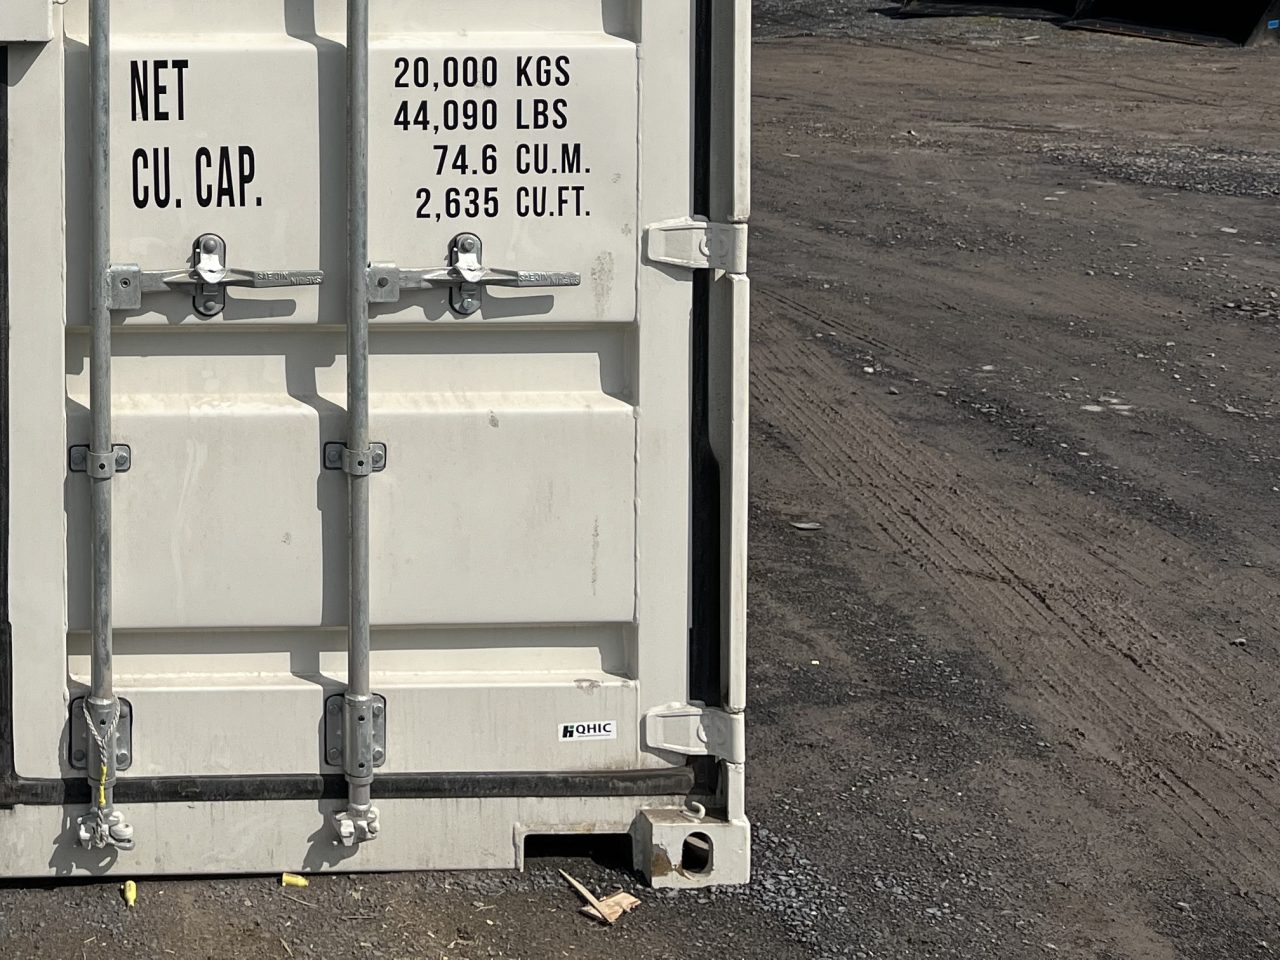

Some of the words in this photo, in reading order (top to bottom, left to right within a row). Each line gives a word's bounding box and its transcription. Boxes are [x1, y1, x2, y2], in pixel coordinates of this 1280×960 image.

[130, 59, 189, 122] NET
[394, 56, 498, 92] 20,000
[516, 55, 570, 87] KGS
[393, 99, 497, 135] 44,090
[516, 98, 568, 130] LBS
[132, 146, 182, 209] CU.
[195, 145, 262, 208] CAP.
[433, 143, 497, 176] 74.6
[516, 143, 591, 175] CU.M.
[416, 186, 499, 223] 2,635
[516, 185, 590, 218] CU.FT.
[575, 722, 612, 735] QHIC
